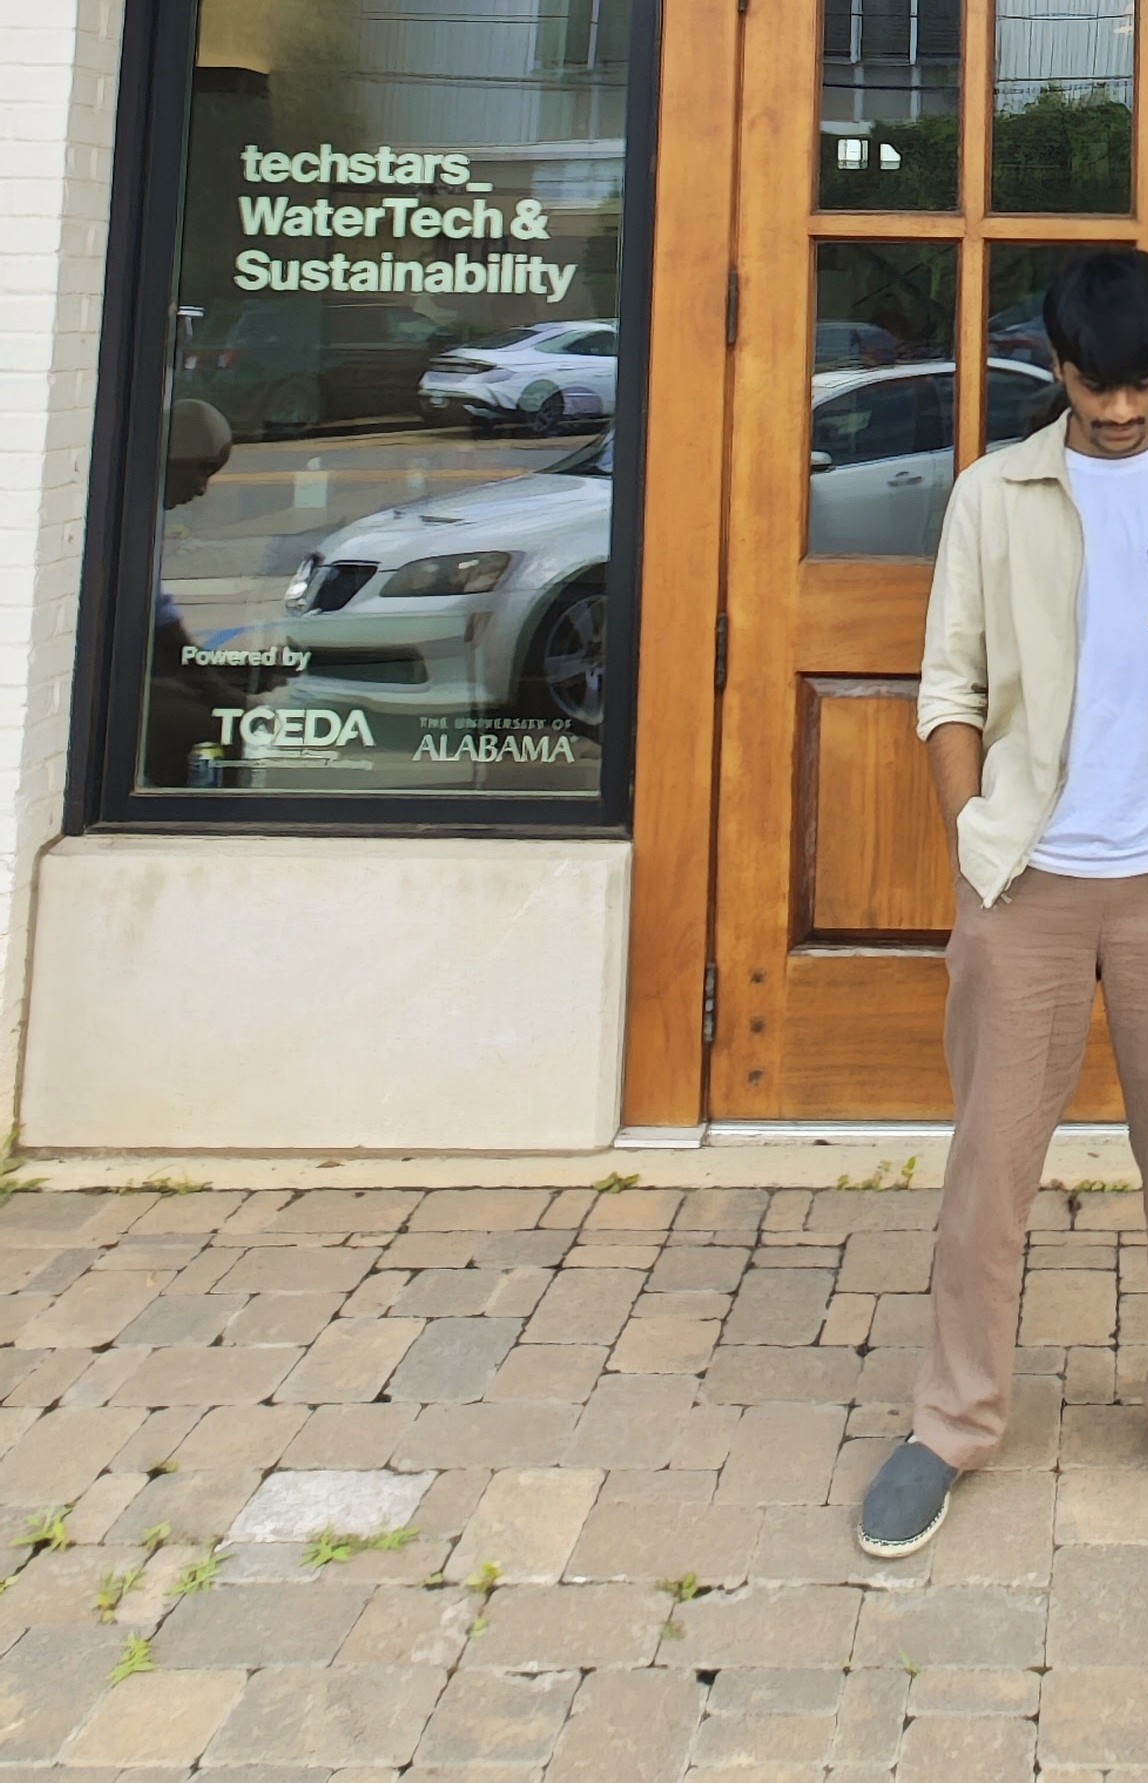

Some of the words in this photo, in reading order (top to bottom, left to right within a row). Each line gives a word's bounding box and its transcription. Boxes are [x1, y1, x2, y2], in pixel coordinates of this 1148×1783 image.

[240, 143, 493, 192] techstars_
[238, 196, 503, 238] WaterTech
[510, 198, 550, 240] &
[233, 249, 578, 303] Sustainability
[181, 646, 277, 666] Powered
[282, 646, 312, 671] by
[551, 718, 573, 731] OF
[412, 734, 575, 763] ALABAMA
